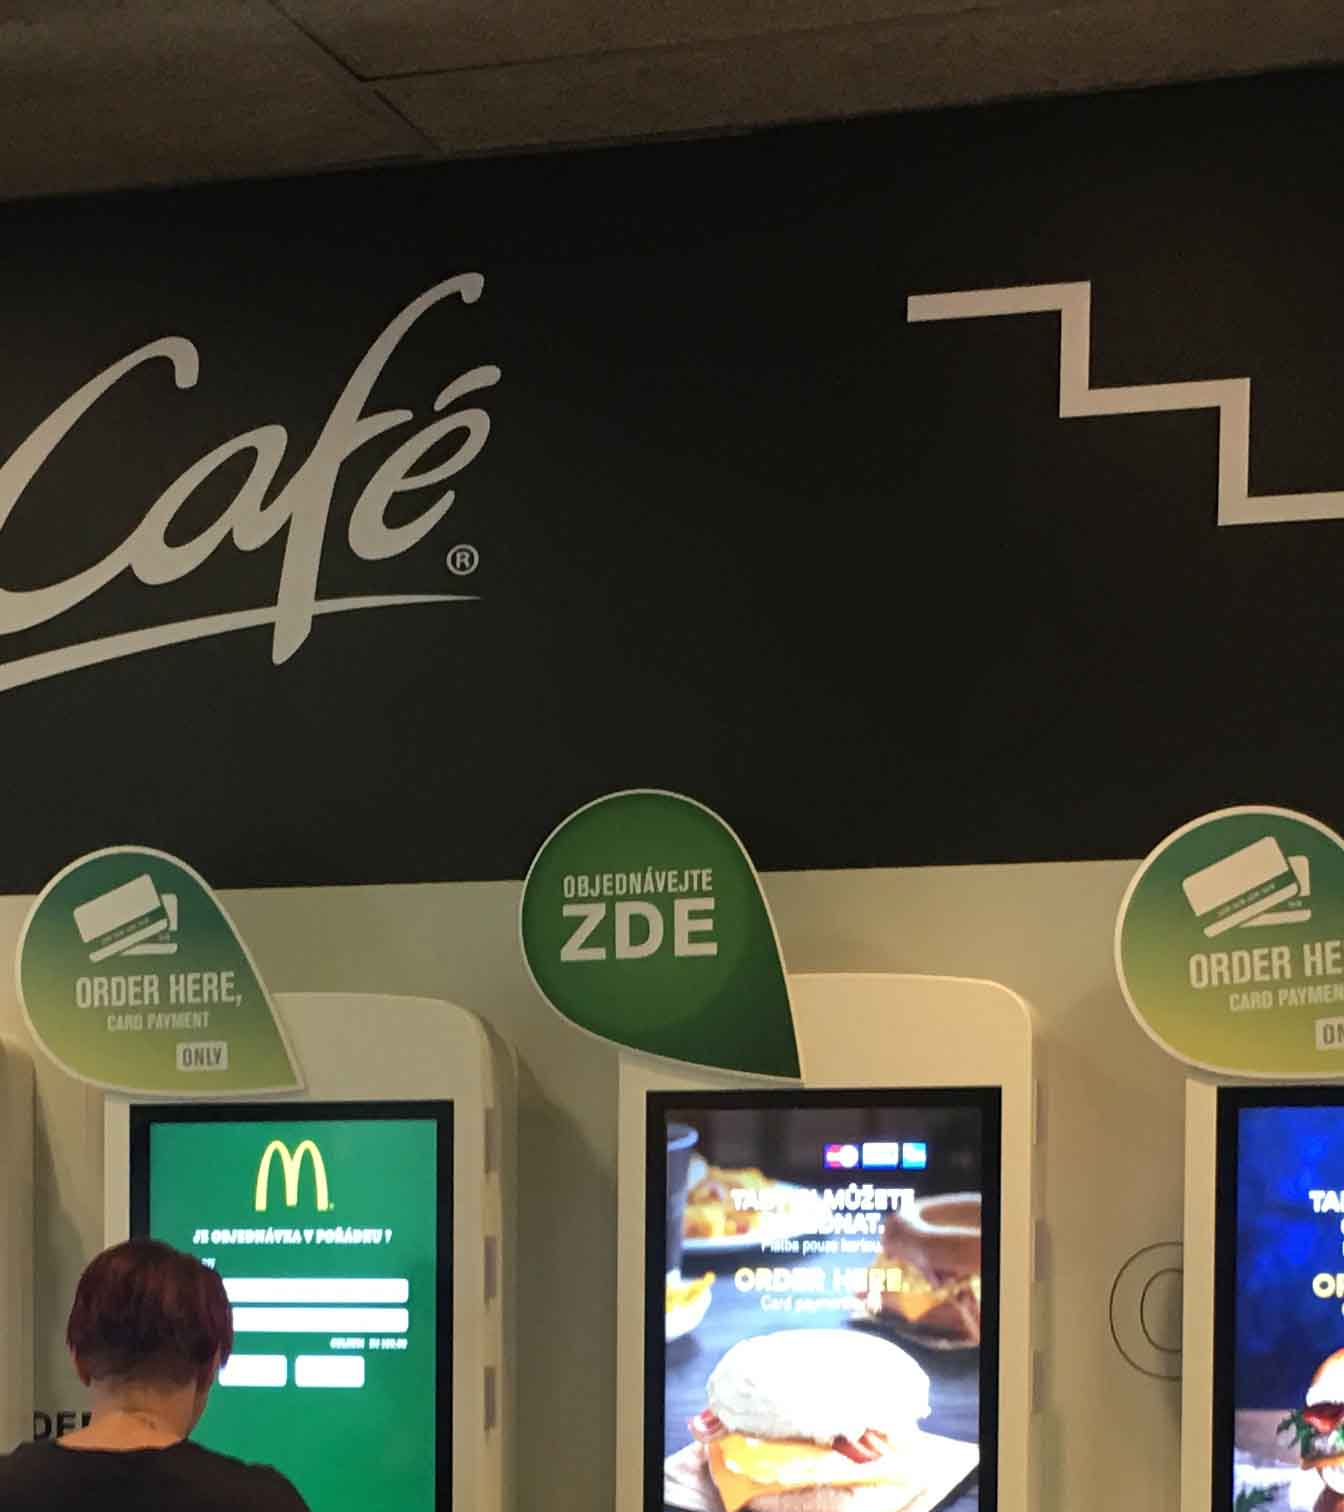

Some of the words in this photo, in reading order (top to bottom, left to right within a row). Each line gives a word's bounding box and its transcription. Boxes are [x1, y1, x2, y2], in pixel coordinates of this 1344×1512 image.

[563, 866, 712, 898] OBJEDNÁVEJTE
[560, 897, 718, 962] ZDE
[1189, 946, 1292, 990] ORDER
[76, 974, 159, 1008] ORDER
[169, 971, 242, 1007] HERE,
[1229, 991, 1273, 1012] CARD
[107, 1013, 143, 1031] CARD
[147, 1011, 209, 1029] PAYMENT
[182, 1048, 223, 1067] ONLY
[735, 1268, 825, 1292] ORDER
